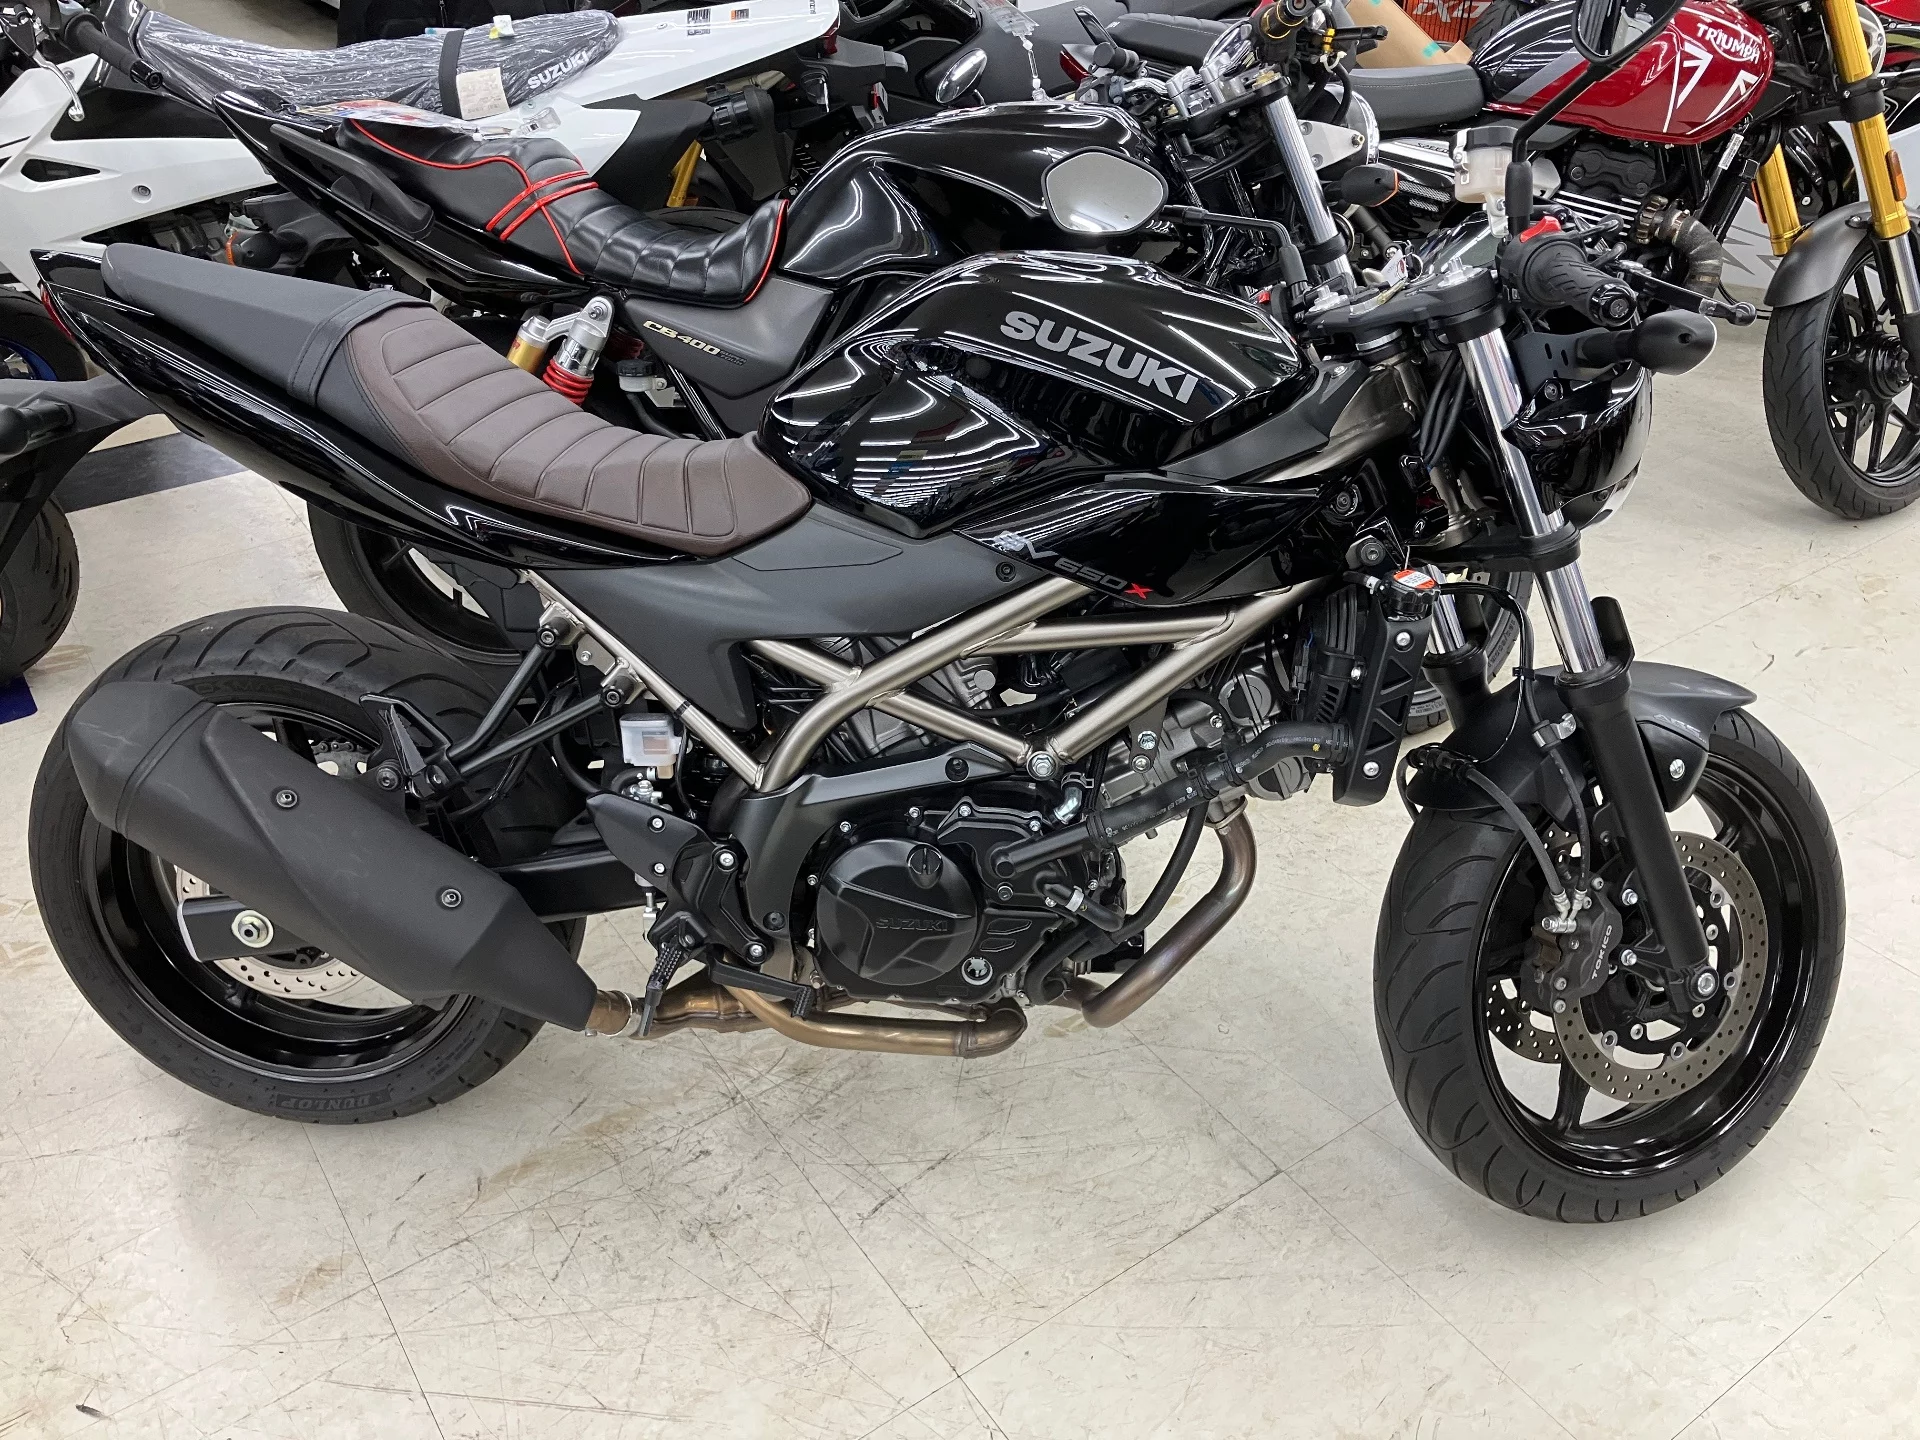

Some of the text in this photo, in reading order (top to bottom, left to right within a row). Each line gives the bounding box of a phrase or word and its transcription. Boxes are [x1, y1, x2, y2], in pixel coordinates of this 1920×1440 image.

[1697, 22, 1760, 65] TRIUMPH
[527, 51, 589, 89] SUZUKI
[1000, 310, 1198, 404] SUZUKI
[876, 917, 948, 932] SUZUKI
[1591, 924, 1613, 980] TOKICO
[281, 1094, 371, 1111] DUNLOP
